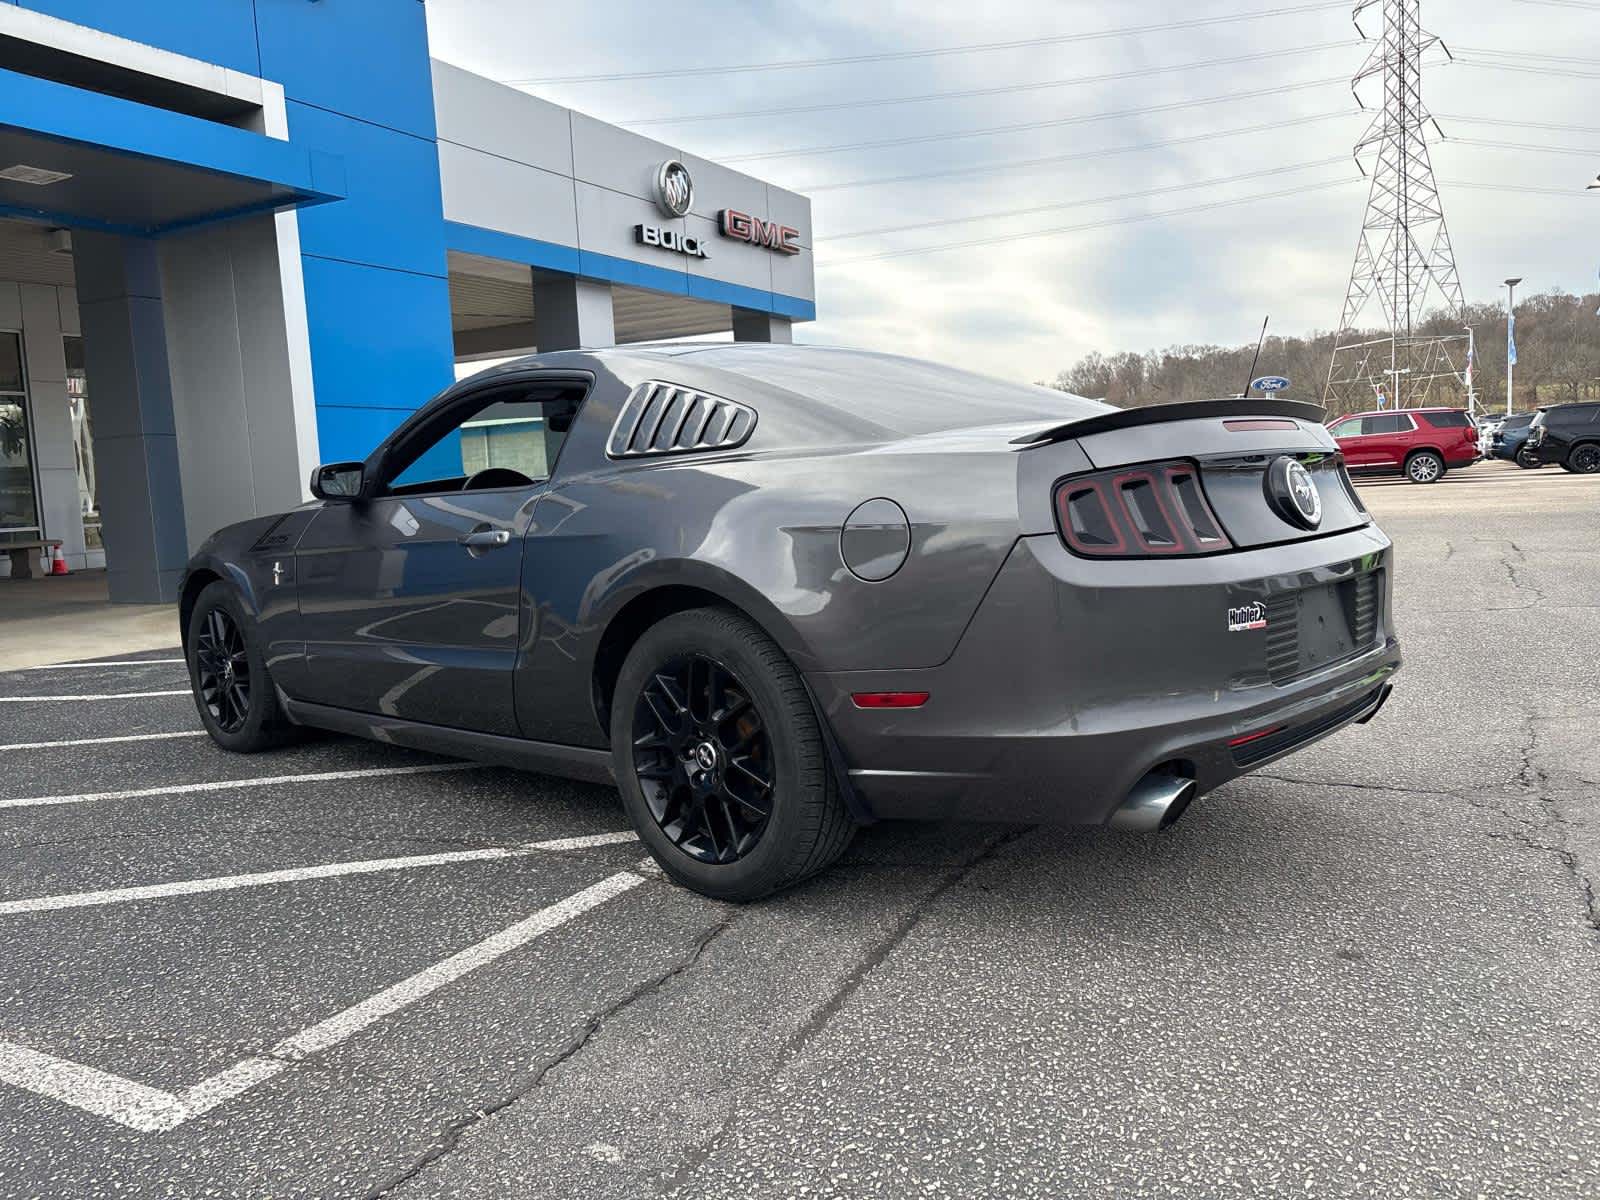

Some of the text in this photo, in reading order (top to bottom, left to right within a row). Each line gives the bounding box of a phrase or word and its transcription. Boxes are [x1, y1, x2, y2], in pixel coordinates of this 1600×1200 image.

[636, 223, 712, 259] BUICK
[719, 208, 801, 255] GMC
[1229, 606, 1260, 626] Hubler
